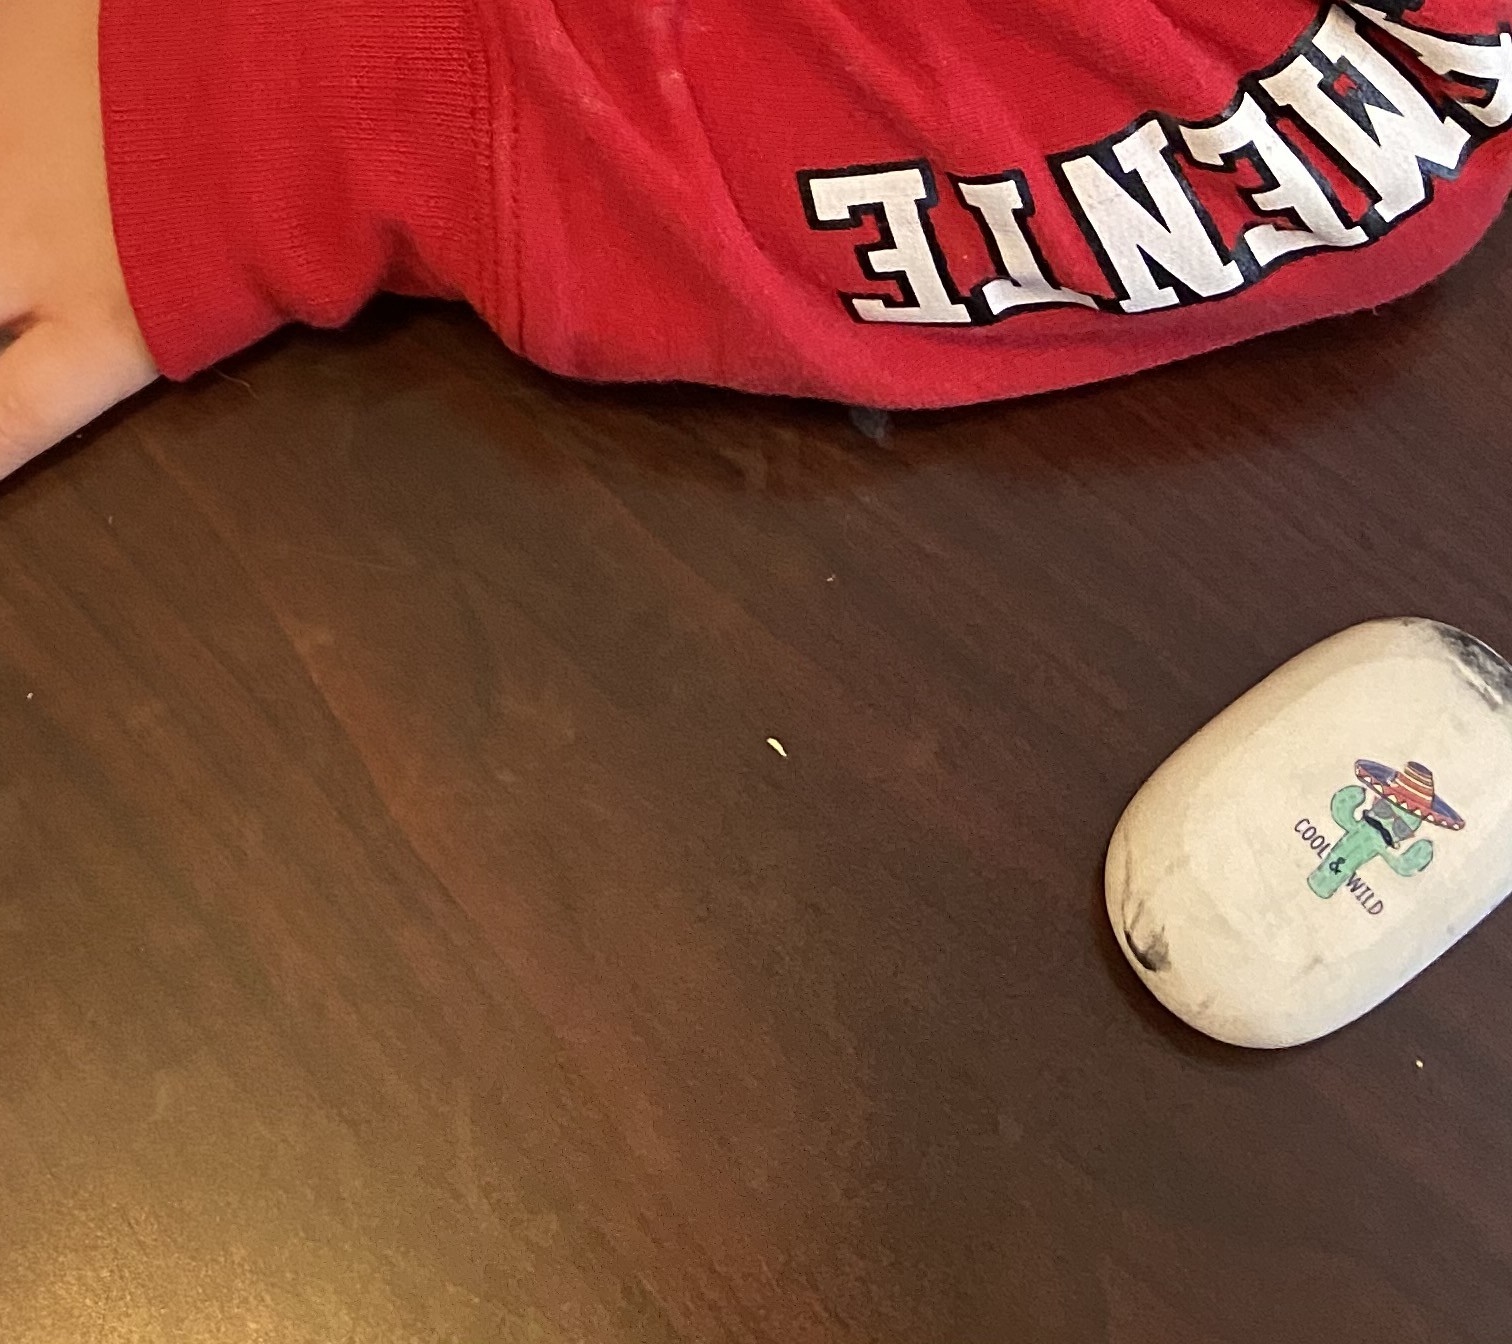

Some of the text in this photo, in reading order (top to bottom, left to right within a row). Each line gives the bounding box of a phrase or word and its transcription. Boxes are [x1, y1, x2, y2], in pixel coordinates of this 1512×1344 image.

[1294, 818, 1384, 915] COOL & WILD
